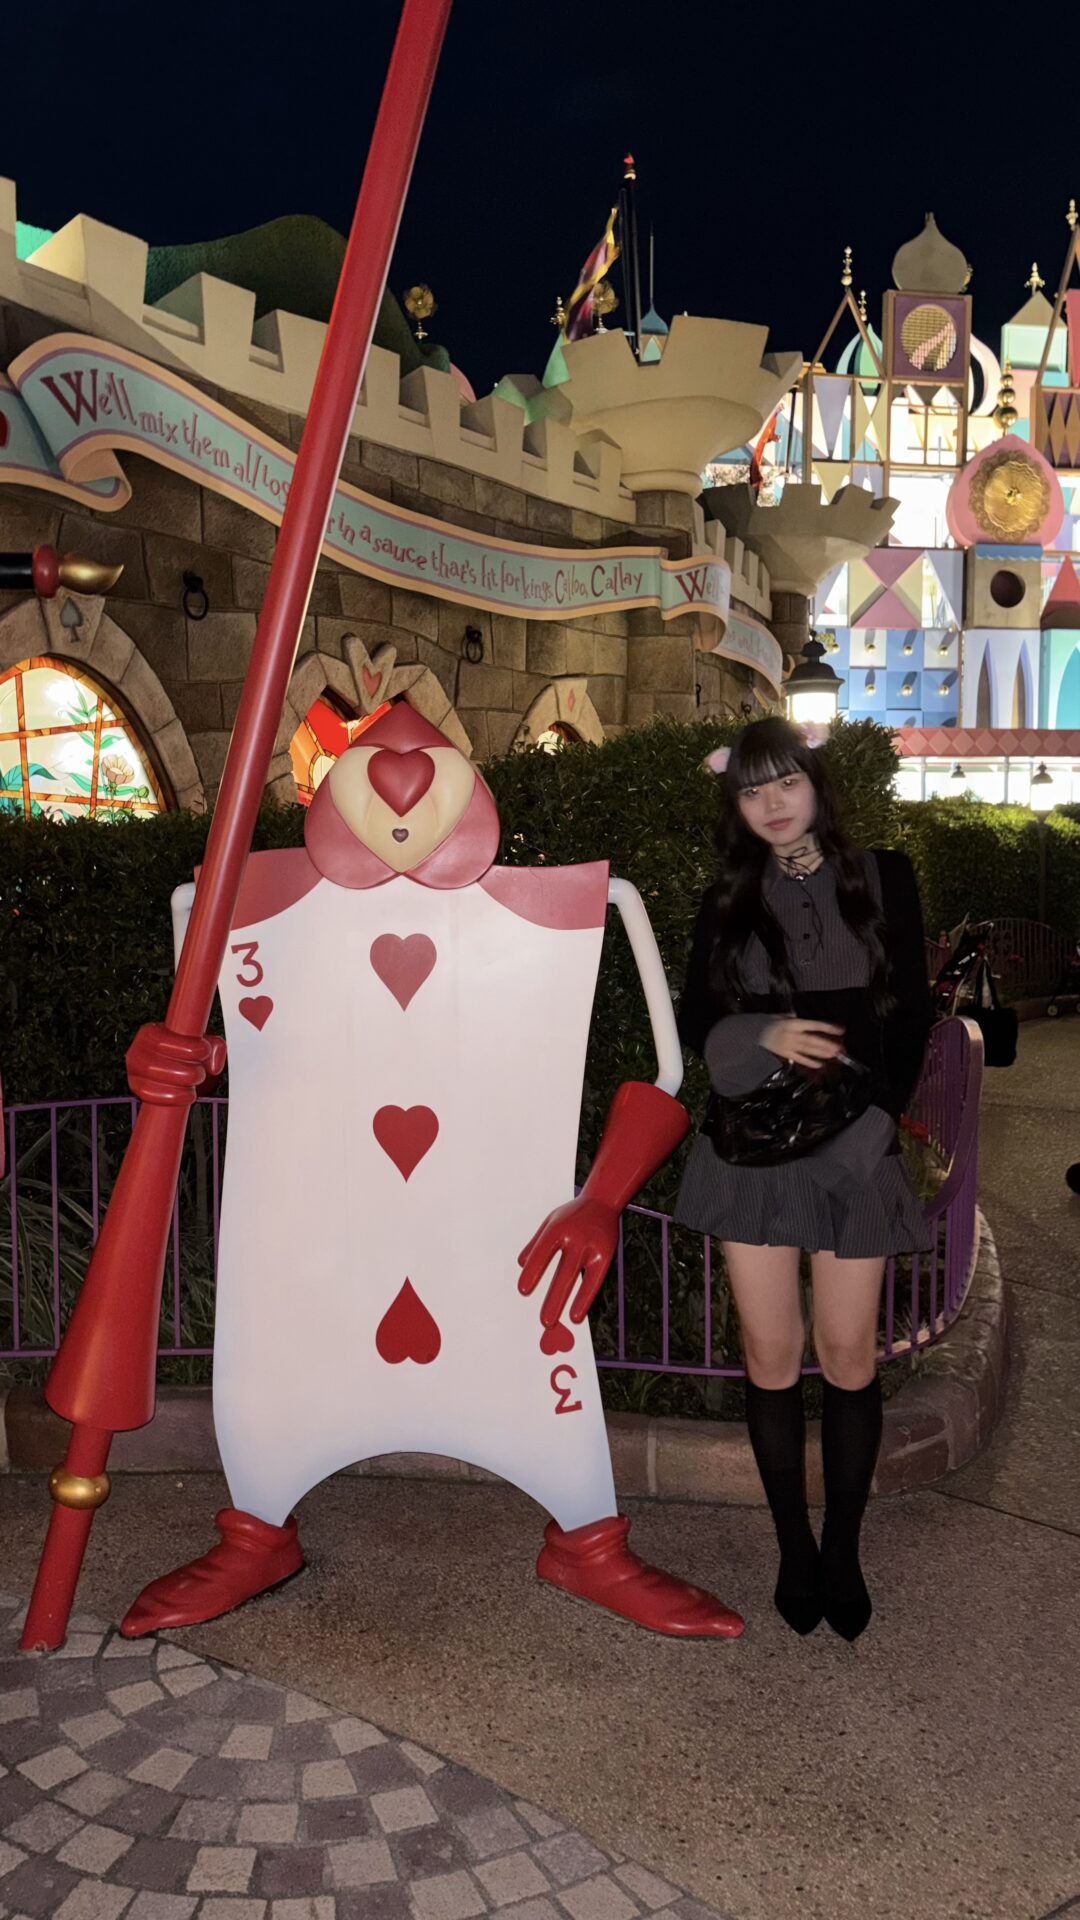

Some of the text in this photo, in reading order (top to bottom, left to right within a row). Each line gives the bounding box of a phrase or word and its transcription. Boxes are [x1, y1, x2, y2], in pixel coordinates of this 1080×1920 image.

[139, 411, 179, 444] mix
[182, 412, 231, 469] them
[233, 442, 262, 491] all
[338, 512, 356, 545] in
[360, 525, 372, 544] a
[372, 537, 428, 570] sauce
[431, 542, 478, 585] that's
[481, 555, 499, 591] fit
[501, 560, 520, 593] for
[591, 561, 643, 597] Callay
[231, 941, 264, 988] 3
[550, 1364, 583, 1415] 3
